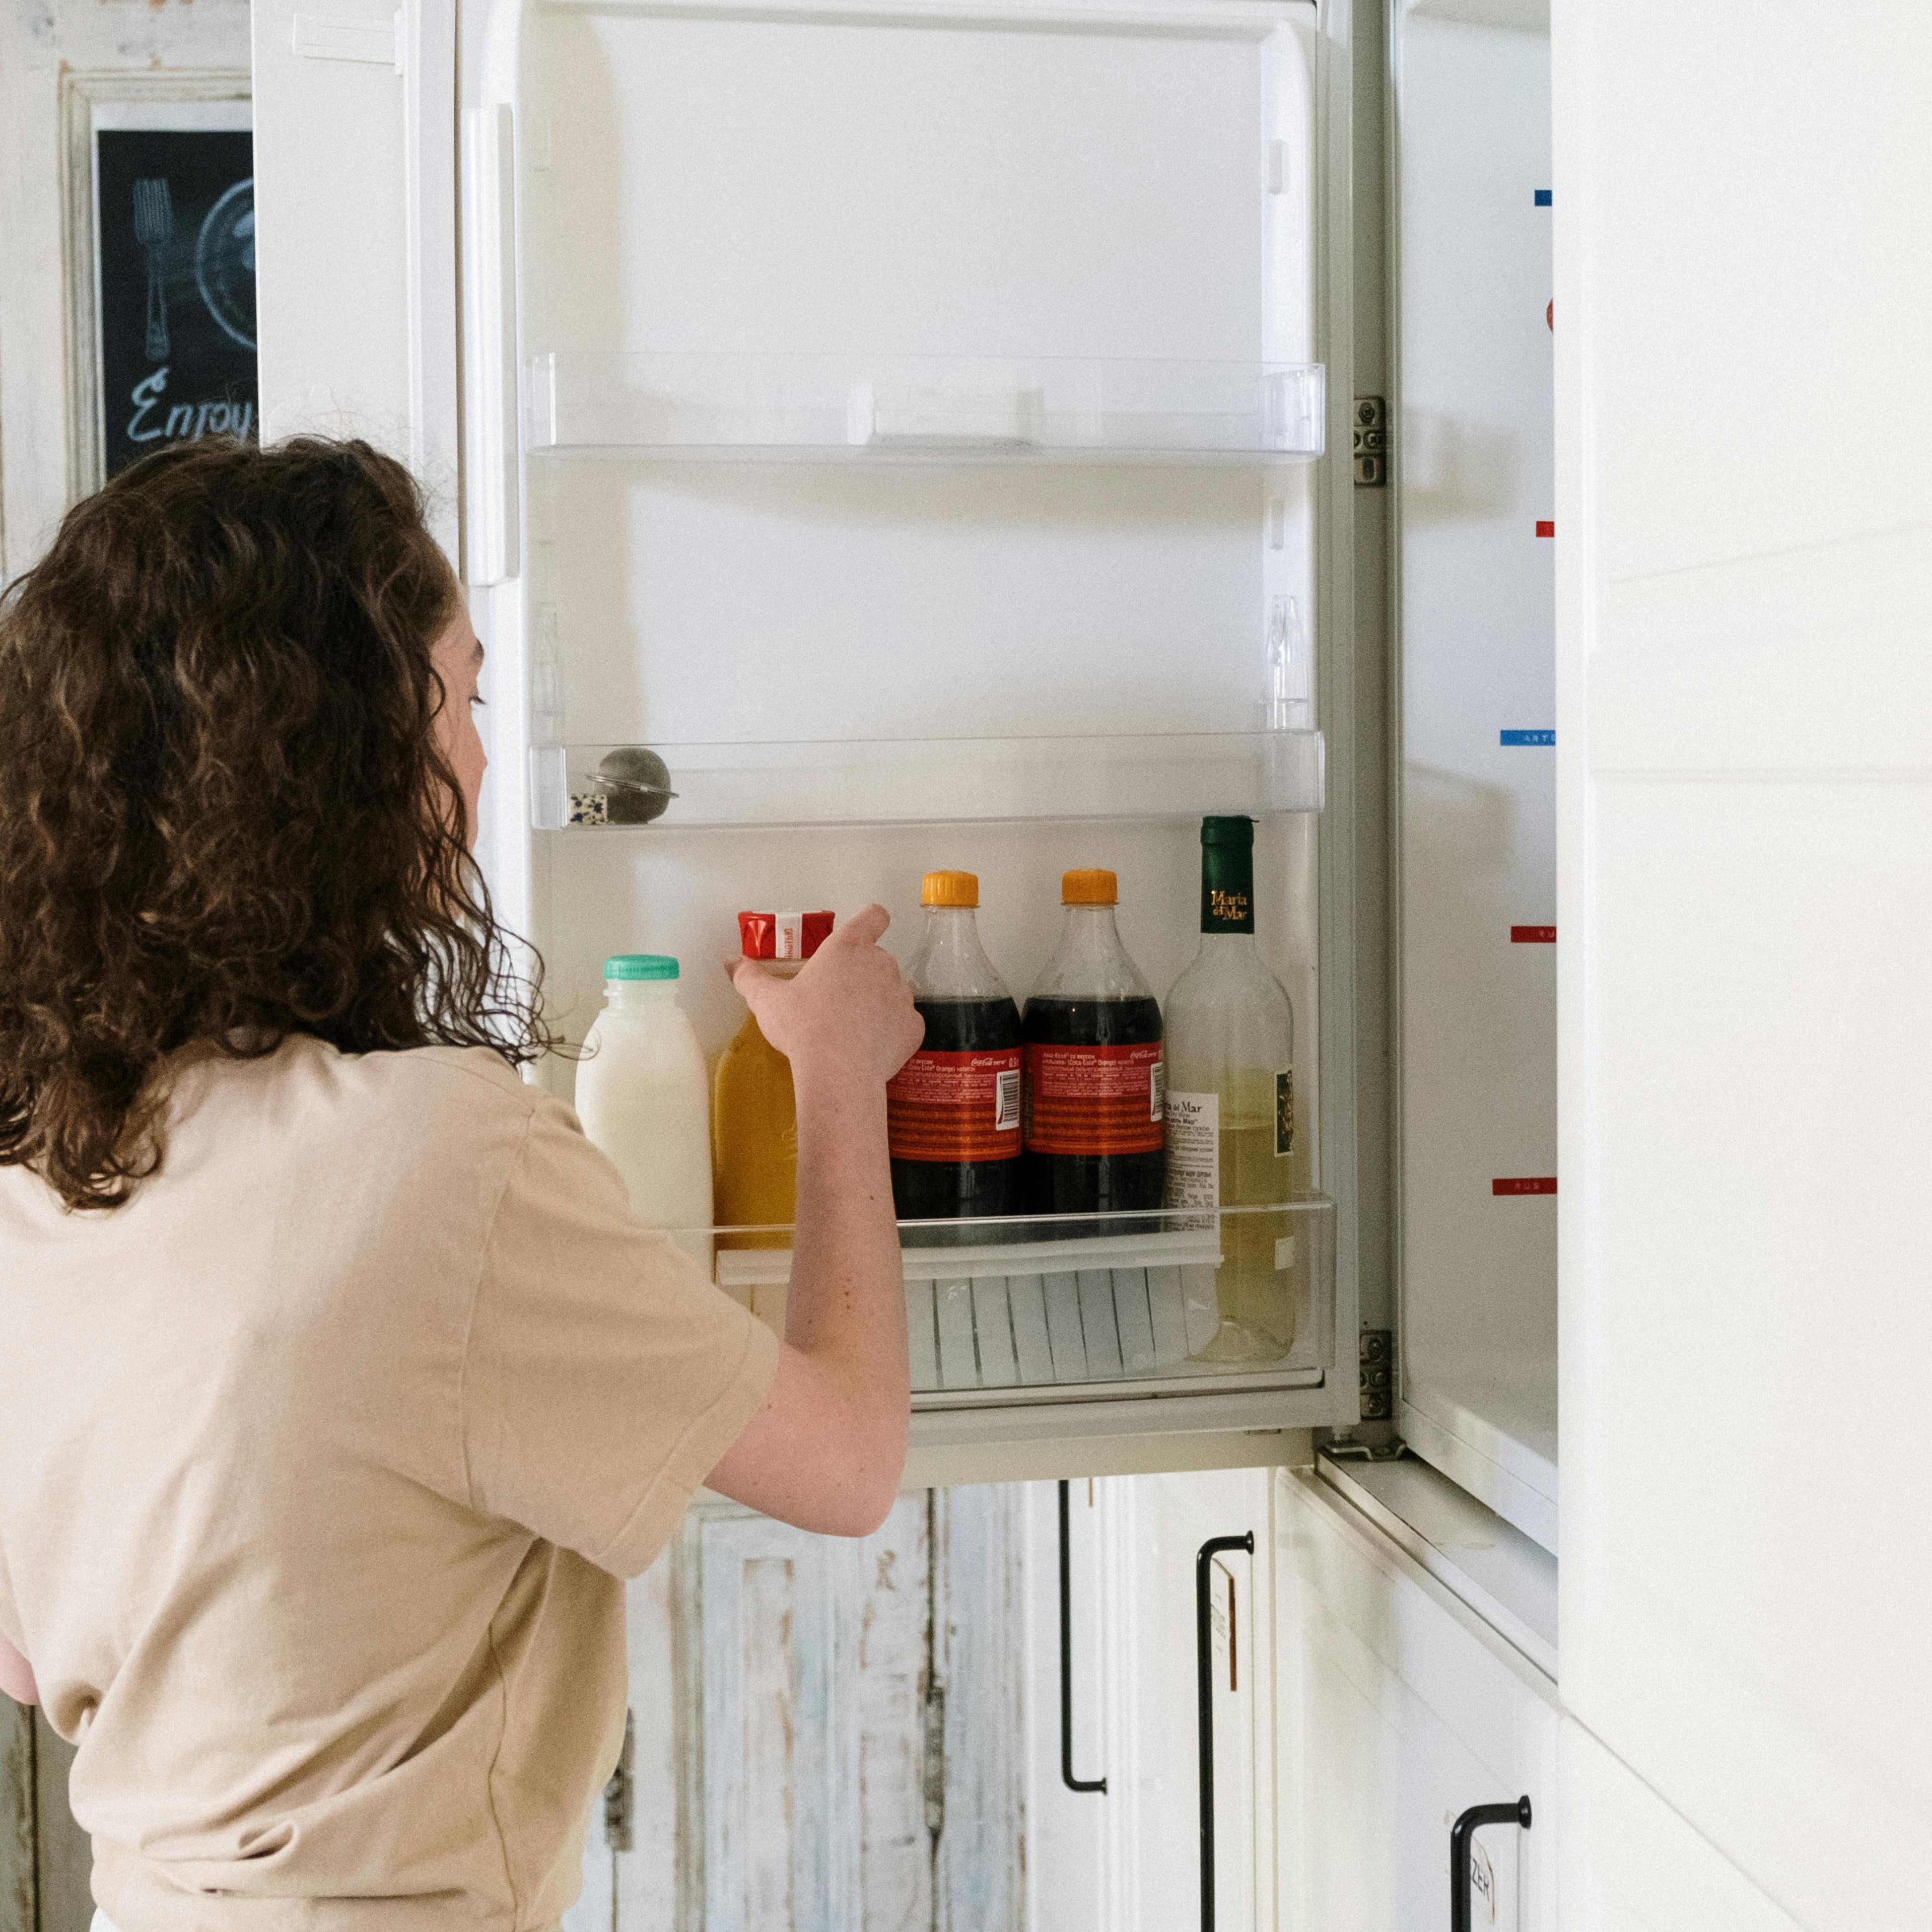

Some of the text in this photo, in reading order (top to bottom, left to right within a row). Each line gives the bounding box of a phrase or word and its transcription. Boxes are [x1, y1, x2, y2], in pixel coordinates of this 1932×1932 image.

[127, 367, 252, 445] Enjoy
[1222, 906, 1248, 920] Mar
[1182, 1101, 1202, 1113] Mar
